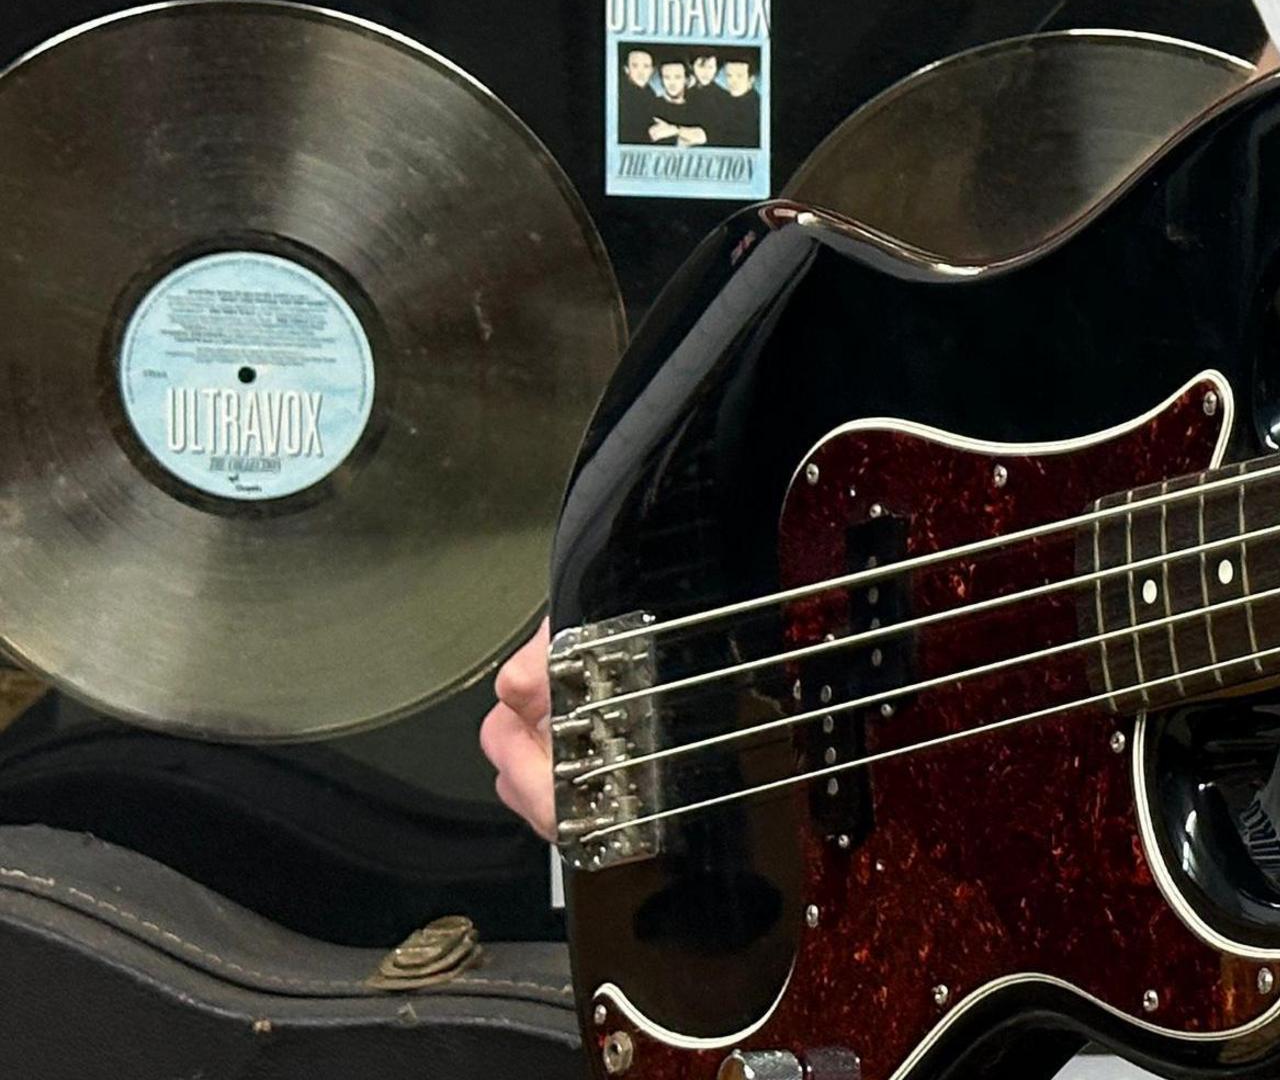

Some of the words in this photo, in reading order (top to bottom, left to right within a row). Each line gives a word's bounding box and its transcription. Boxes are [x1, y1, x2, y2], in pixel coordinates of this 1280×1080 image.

[618, 151, 649, 177] THE
[652, 152, 754, 182] COLLECTION
[167, 387, 325, 458] ULTRAVOX
